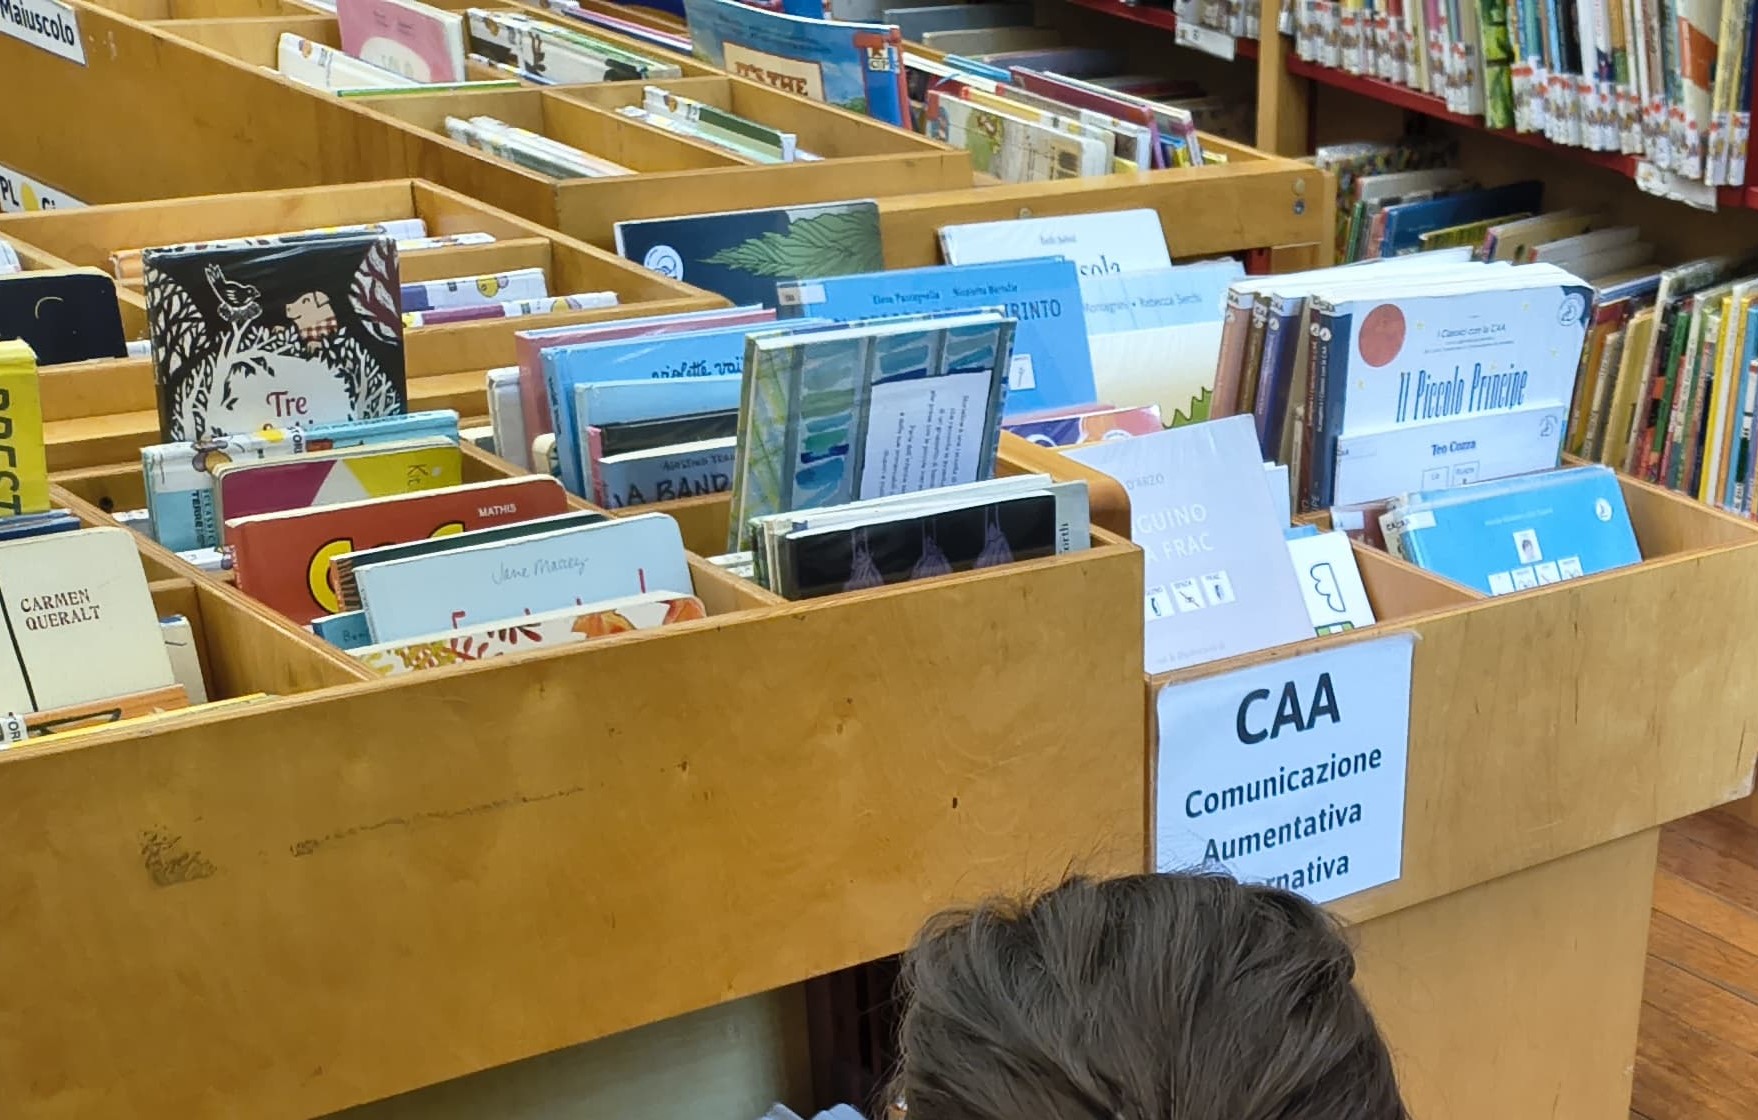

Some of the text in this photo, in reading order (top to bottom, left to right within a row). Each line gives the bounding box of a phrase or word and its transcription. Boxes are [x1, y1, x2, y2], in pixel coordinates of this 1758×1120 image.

[266, 390, 308, 417] Tre
[1396, 362, 1530, 424] Il Piccolo Principe
[1431, 442, 1447, 457] Teo
[656, 472, 731, 504] BAND
[477, 502, 517, 518] MATHIS
[20, 588, 91, 614] CARMEN
[25, 603, 102, 632] QUERALT
[1236, 672, 1341, 745] CAA
[1185, 748, 1382, 819] Comunicazione
[1202, 803, 1362, 866] Aumentativa
[1264, 855, 1350, 892] rnativa
